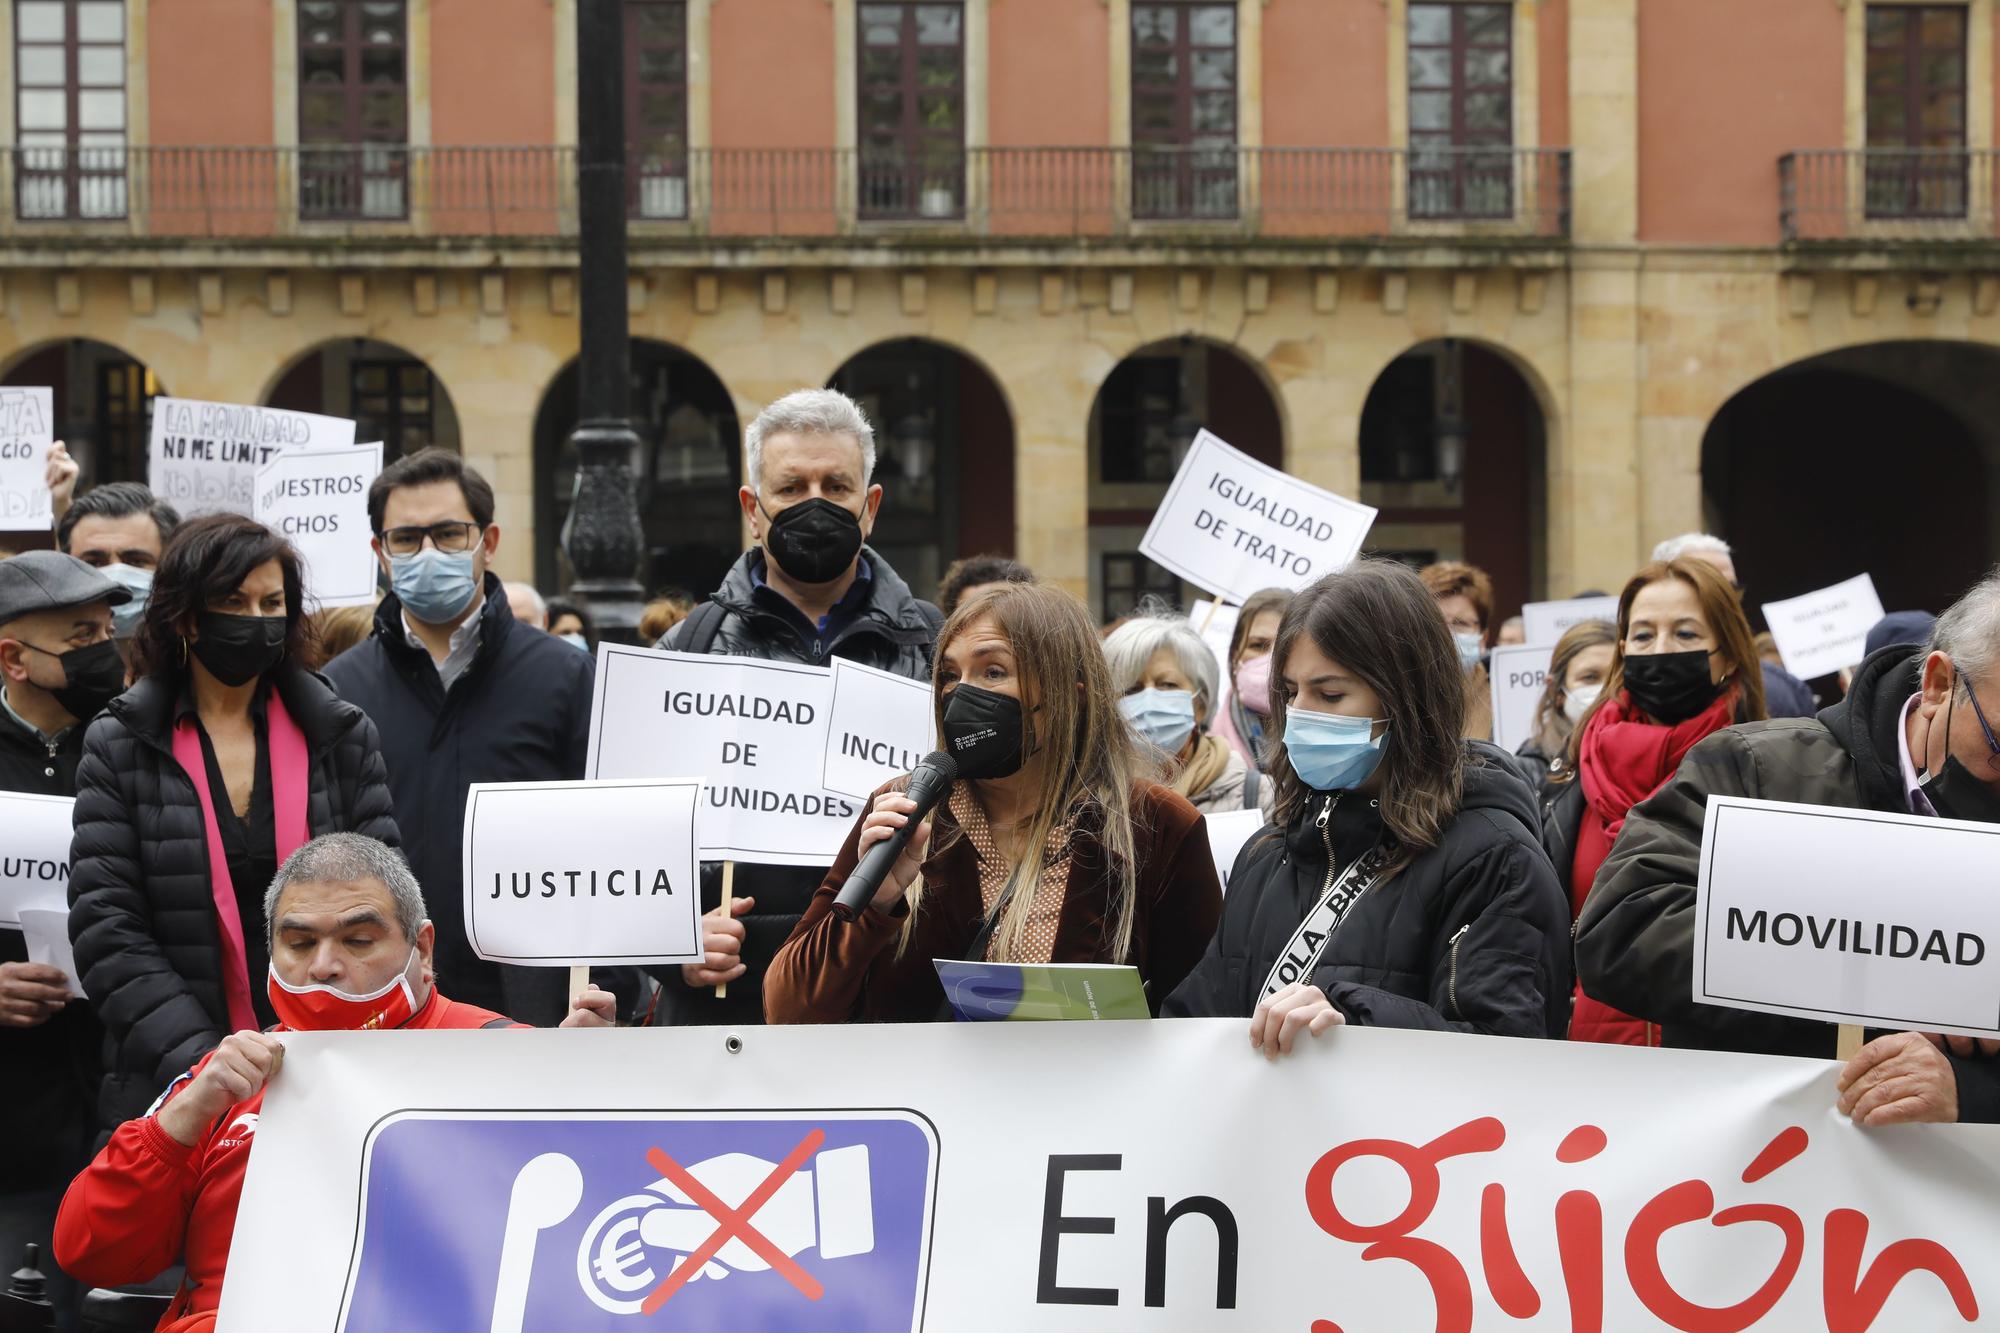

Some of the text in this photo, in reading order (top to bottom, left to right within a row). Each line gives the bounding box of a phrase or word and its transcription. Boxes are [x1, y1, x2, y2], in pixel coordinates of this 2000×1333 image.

[0, 390, 45, 436] TA
[164, 436, 281, 465] NO ME LIMIT
[275, 475, 363, 498] UESTROS
[1209, 472, 1333, 542] IGUALDAD
[1194, 509, 1311, 577] DE TRATO
[663, 690, 815, 725] IGUALDAD
[721, 742, 758, 766] DE
[841, 732, 920, 772] INCLU
[0, 857, 71, 882] UTON
[491, 869, 673, 899] JUSTICIA
[1726, 907, 1986, 966] MOVILIDAD
[1037, 1116, 1979, 1333] En gijón
